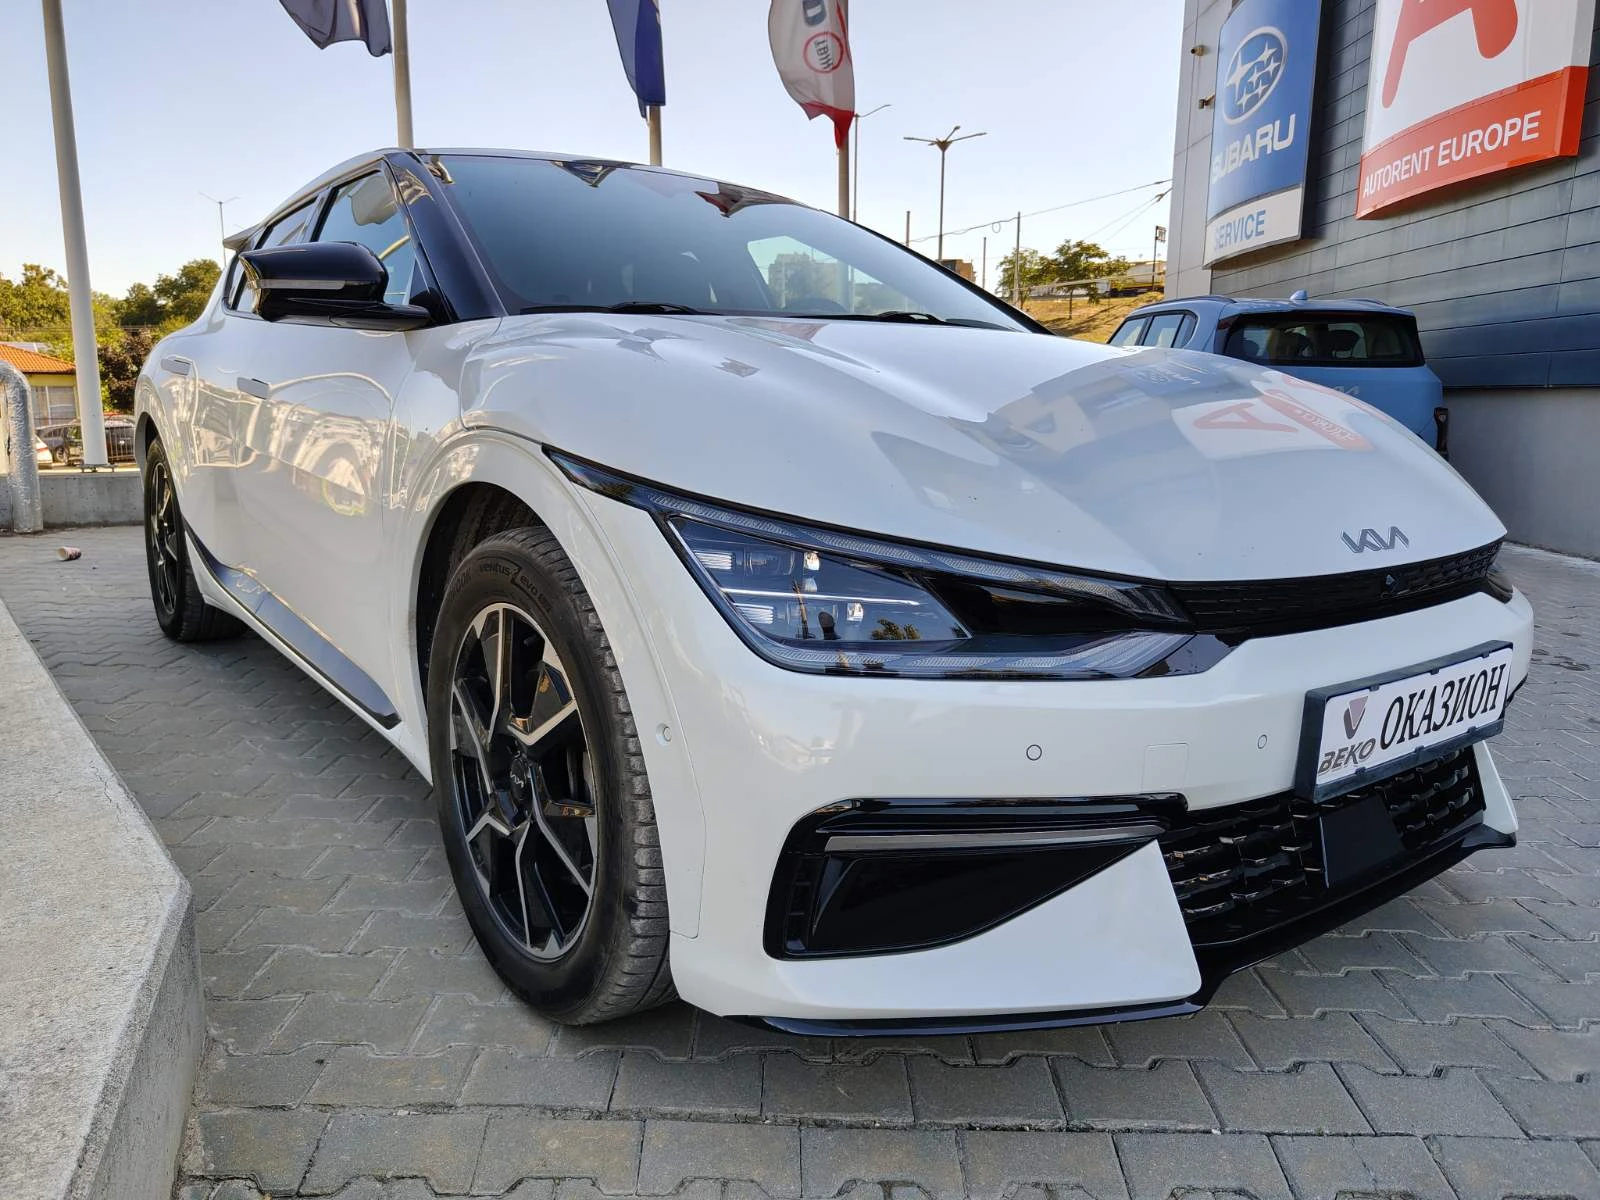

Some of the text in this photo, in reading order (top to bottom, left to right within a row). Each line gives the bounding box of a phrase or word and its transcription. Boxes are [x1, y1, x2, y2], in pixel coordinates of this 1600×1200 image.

[1211, 113, 1297, 185] SUBARU
[1362, 110, 1542, 198] AUTORENT EUROPE
[1380, 664, 1507, 750] ОКАЗИОН
